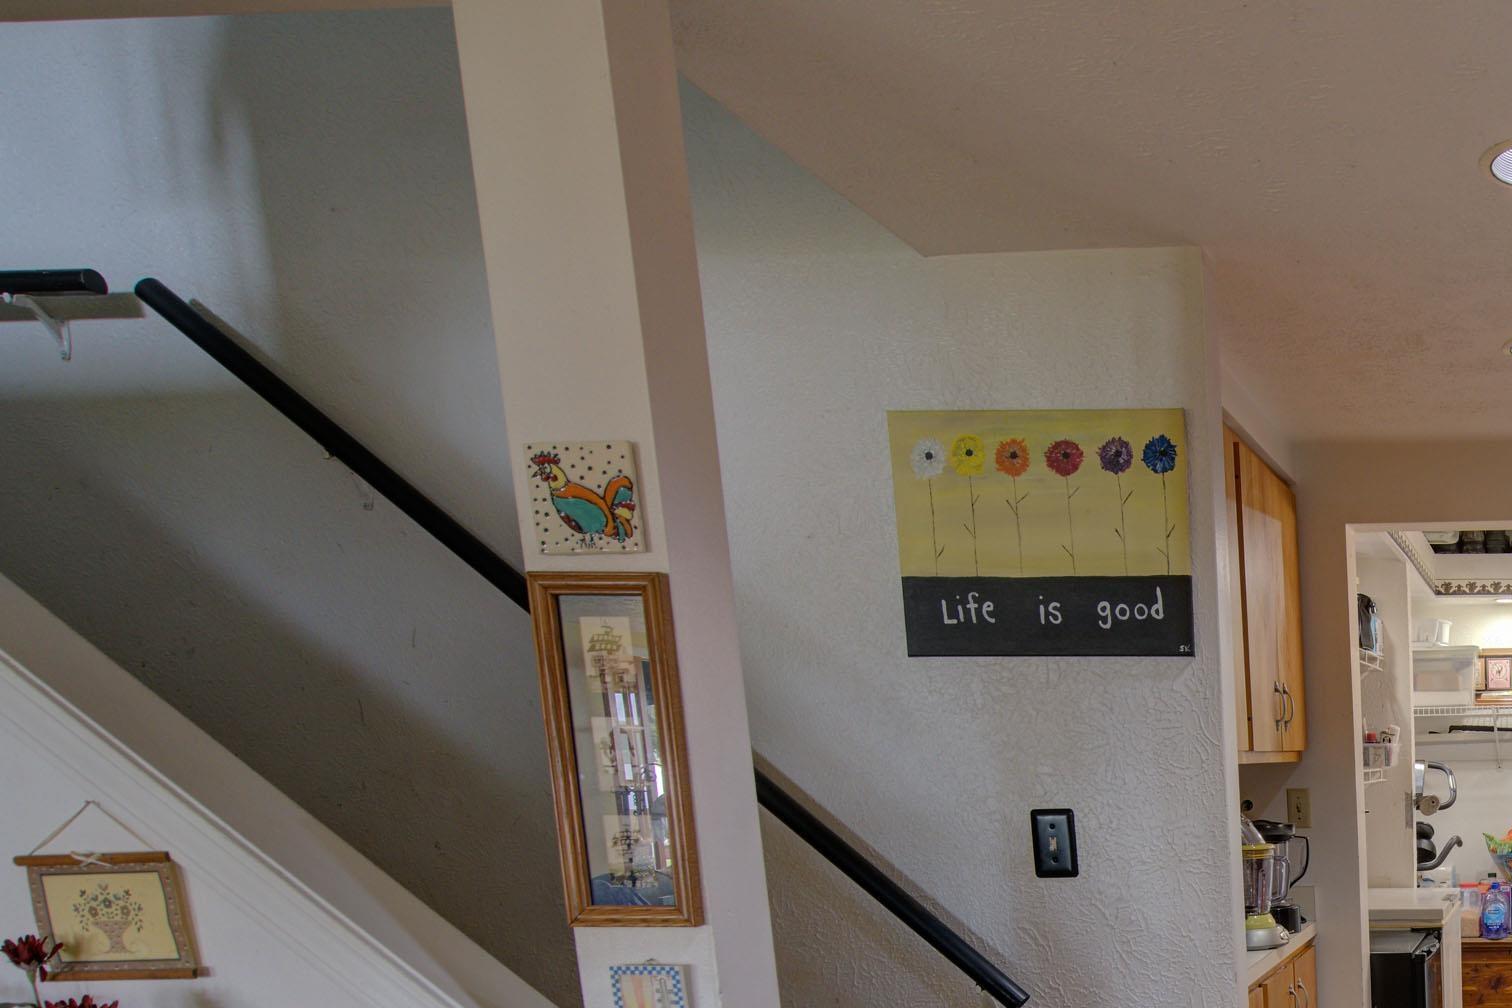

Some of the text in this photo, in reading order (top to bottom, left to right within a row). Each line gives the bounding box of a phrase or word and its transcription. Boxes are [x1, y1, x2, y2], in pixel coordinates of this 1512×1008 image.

[941, 586, 1165, 629] Life is good
